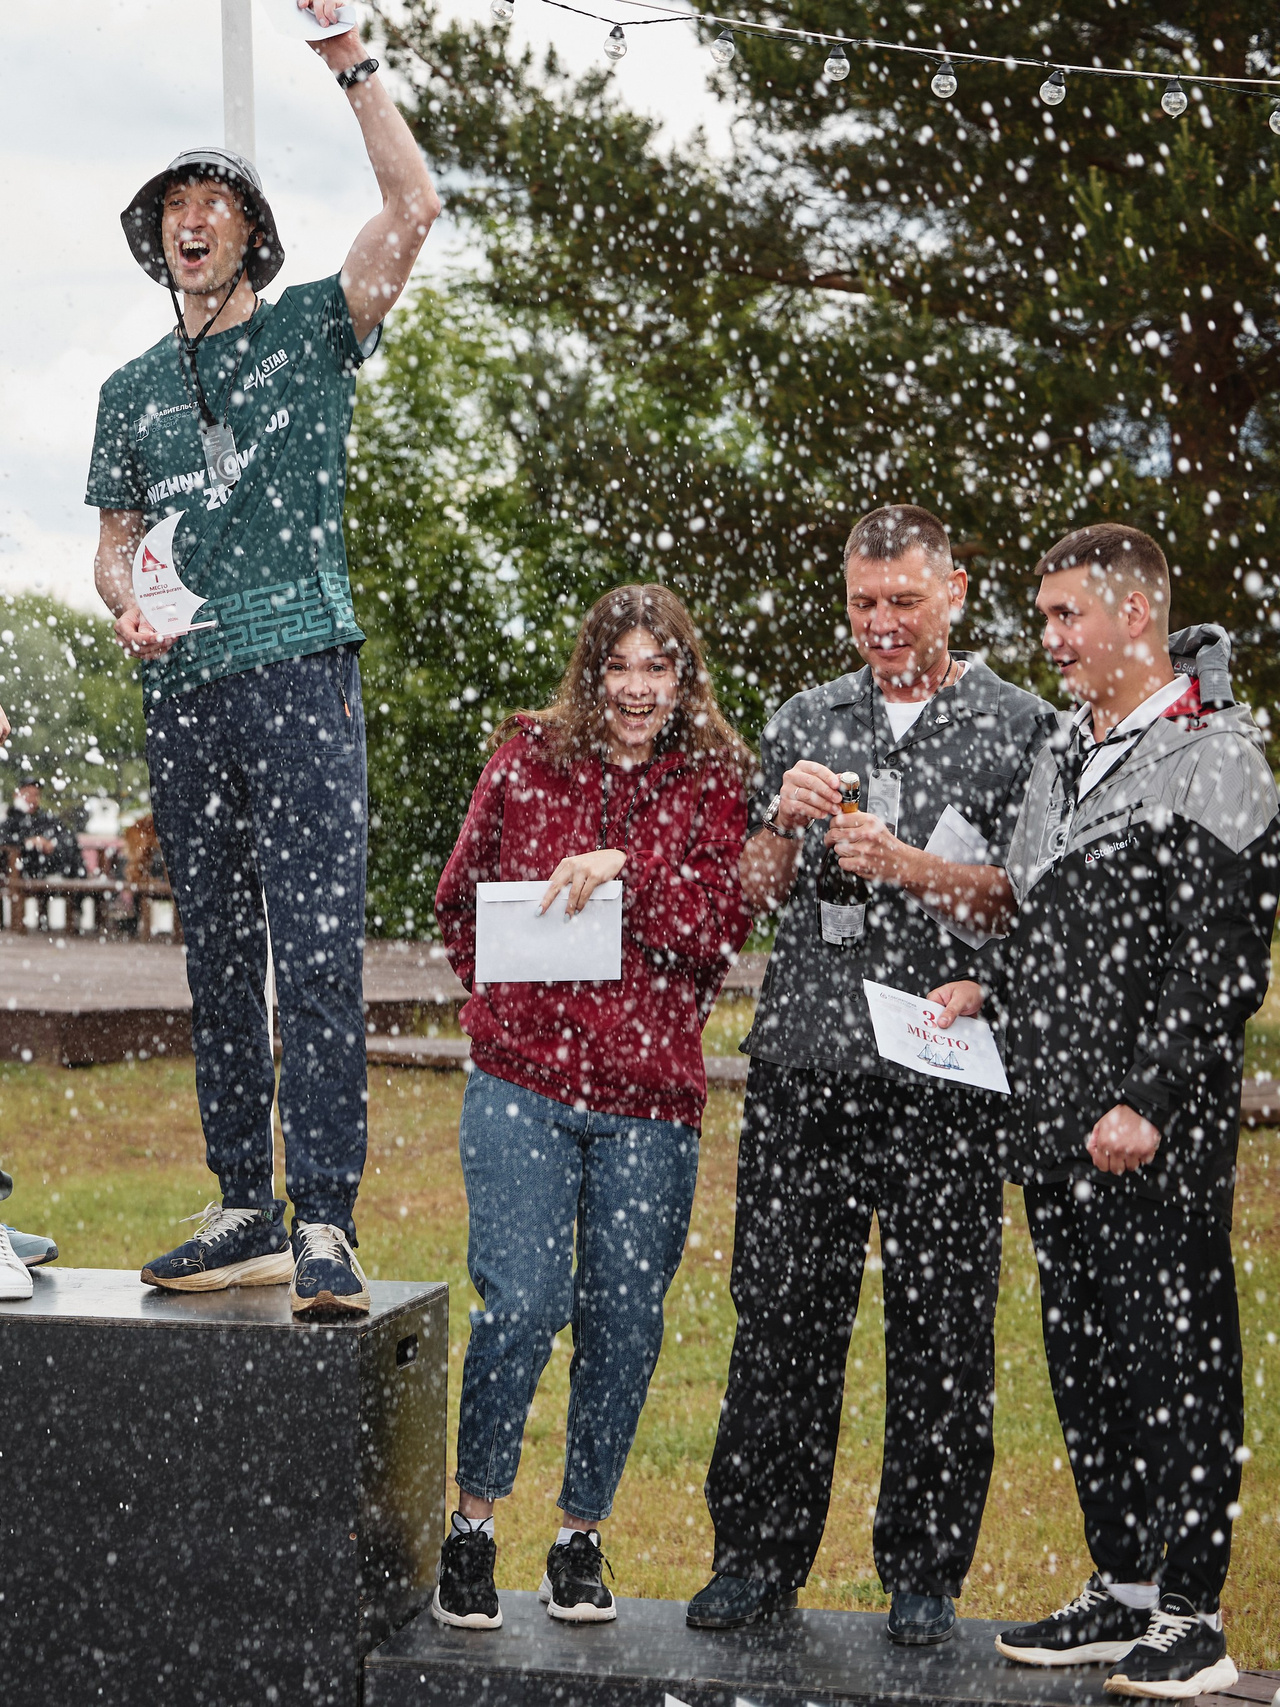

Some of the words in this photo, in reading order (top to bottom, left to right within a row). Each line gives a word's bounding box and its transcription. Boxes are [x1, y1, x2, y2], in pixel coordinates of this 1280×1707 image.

[261, 349, 288, 373] STAR
[146, 468, 206, 506] NIZHNY
[922, 1010, 937, 1029] 3
[906, 1023, 969, 1051] МЕСТО
